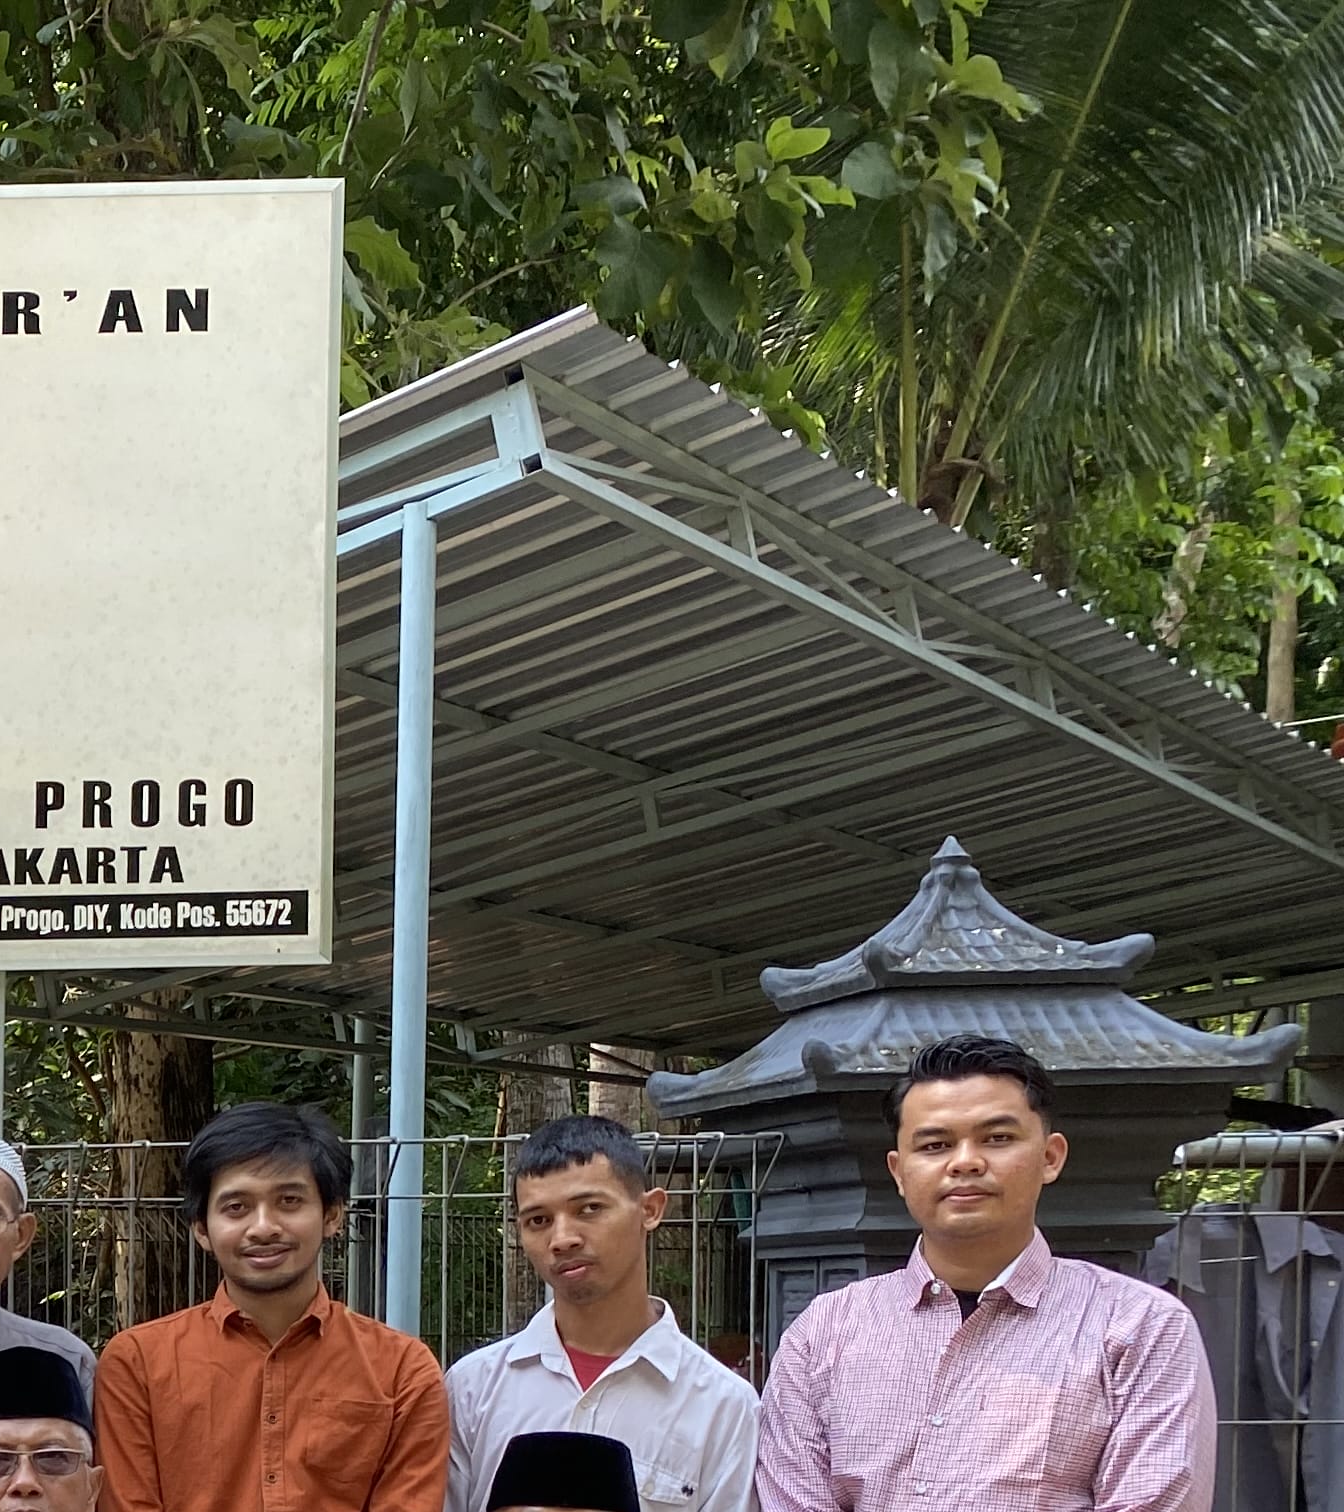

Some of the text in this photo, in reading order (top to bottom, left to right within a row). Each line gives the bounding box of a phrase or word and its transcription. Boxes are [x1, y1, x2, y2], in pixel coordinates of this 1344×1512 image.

[35, 778, 254, 829] PROGO
[0, 904, 70, 935] Progo,
[73, 903, 112, 934] DIY,
[119, 902, 172, 930] Kode
[176, 901, 221, 929] Pos.
[225, 898, 292, 926] 55672
